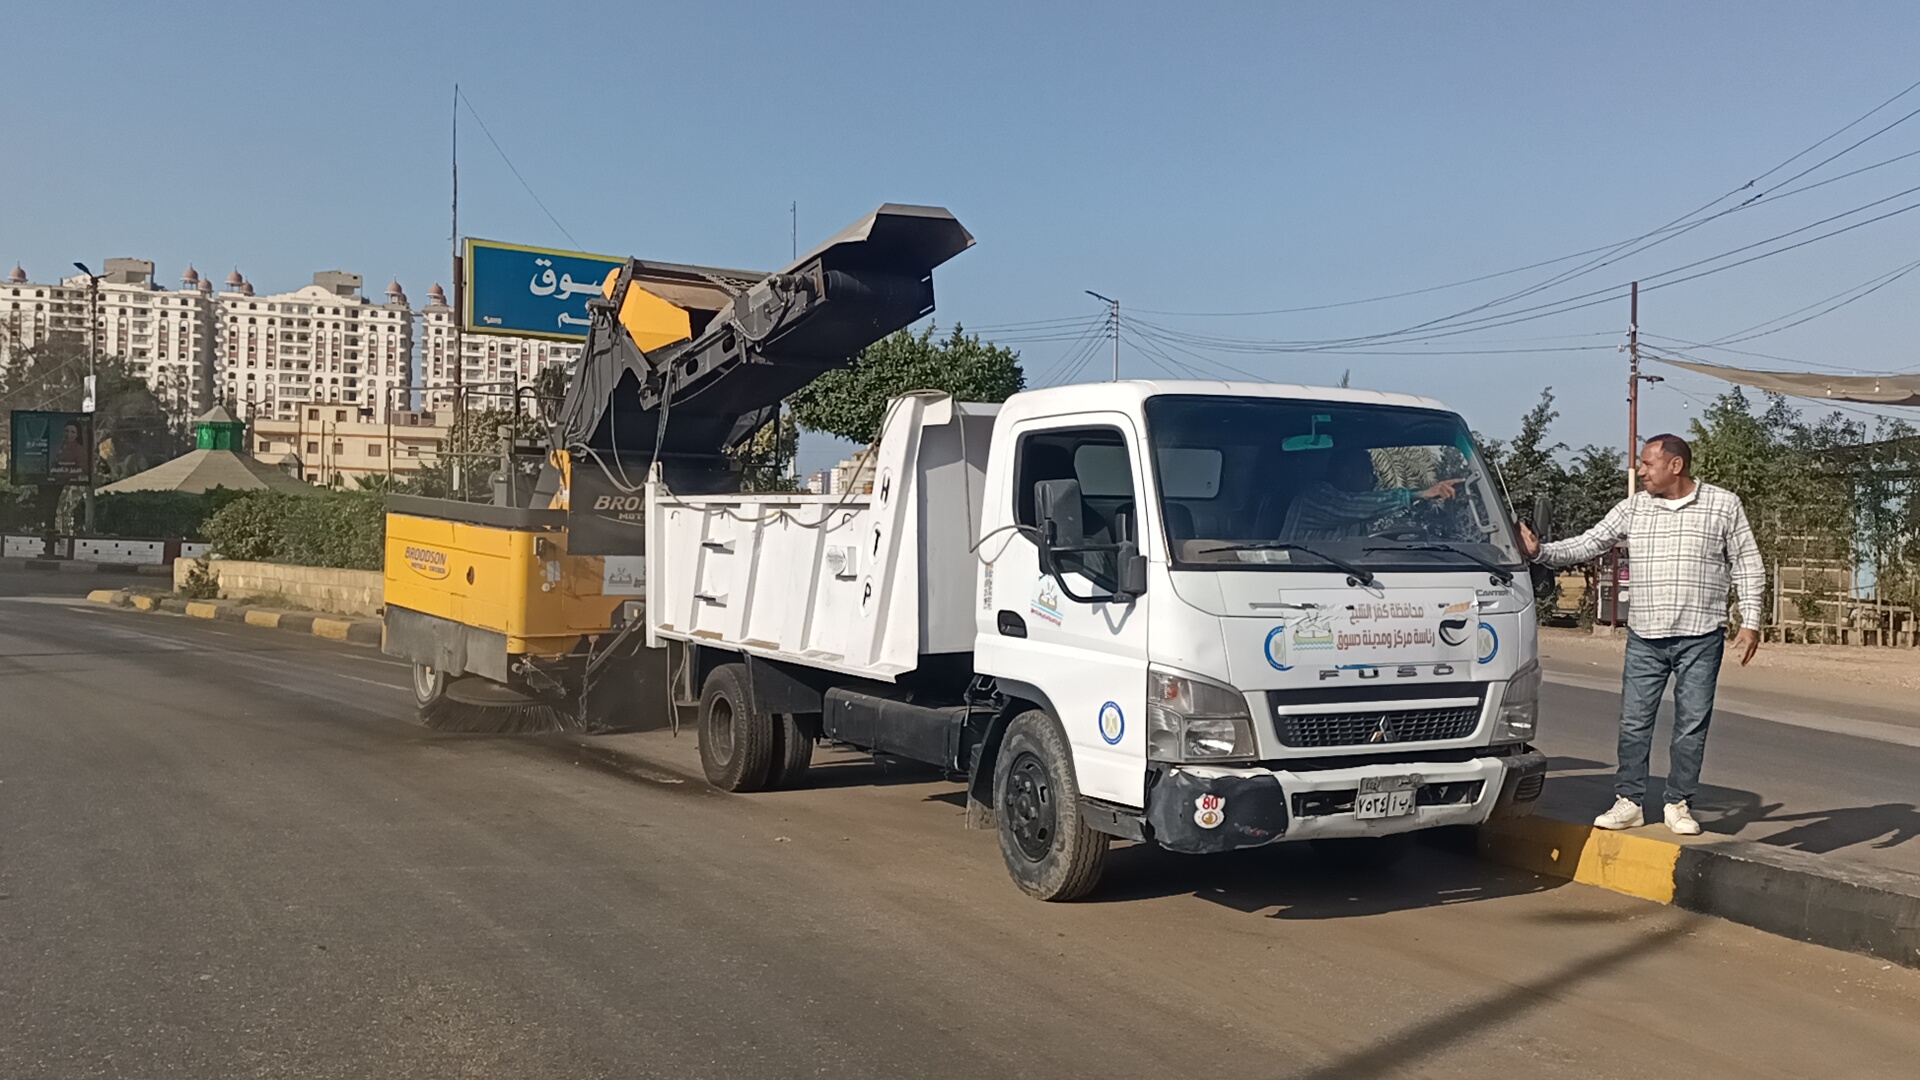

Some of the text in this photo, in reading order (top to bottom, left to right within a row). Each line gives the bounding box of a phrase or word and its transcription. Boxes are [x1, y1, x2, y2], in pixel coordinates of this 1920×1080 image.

[405, 546, 447, 566] BRODDSON
[1373, 603, 1389, 622] كفر
[1390, 603, 1424, 619] محافظة
[1336, 630, 1361, 650] دسوق
[1362, 629, 1392, 649] ومدينة
[1393, 629, 1412, 648] مركز
[1319, 663, 1454, 680] FUSO
[1202, 795, 1219, 810] 80
